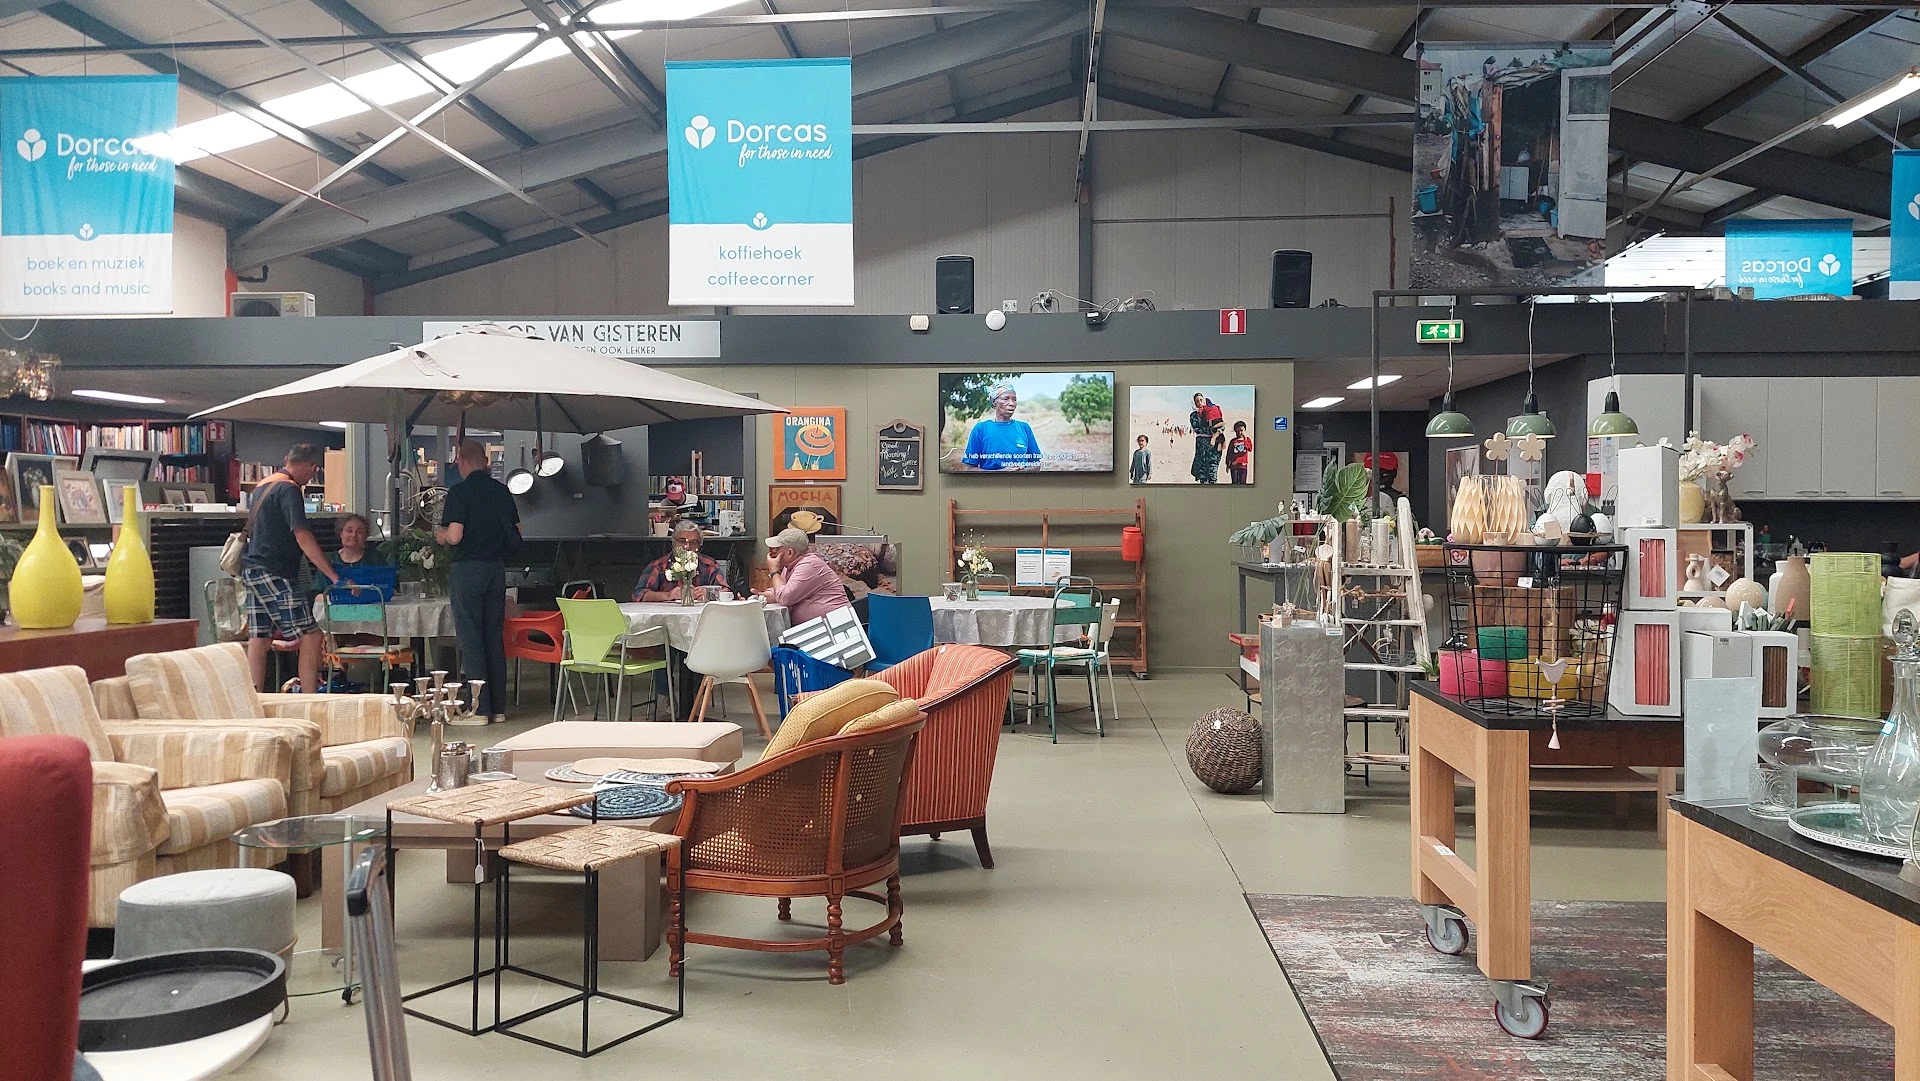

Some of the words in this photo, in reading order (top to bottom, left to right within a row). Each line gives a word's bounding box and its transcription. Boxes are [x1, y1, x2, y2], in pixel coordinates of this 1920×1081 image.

[727, 119, 828, 143] Dorcas
[738, 143, 757, 168] for
[758, 144, 789, 160] those
[790, 147, 804, 160] in
[805, 144, 834, 160] need
[67, 156, 83, 180] for
[86, 158, 117, 172] those
[117, 163, 132, 172] in
[132, 157, 158, 172] need
[719, 245, 802, 260] koffiehoek
[27, 256, 65, 270] boek
[68, 259, 87, 270] en
[92, 256, 145, 270] muziek
[707, 271, 815, 286] coffeecorner
[23, 282, 67, 296] books
[71, 281, 101, 295] and
[105, 281, 150, 296] music
[548, 324, 584, 342] VAN
[593, 324, 681, 342] GISTEREN
[600, 346, 622, 355] OOK
[626, 346, 656, 355] LEKKER
[785, 416, 831, 426] ORANGINA
[777, 490, 832, 503] MOCHA
